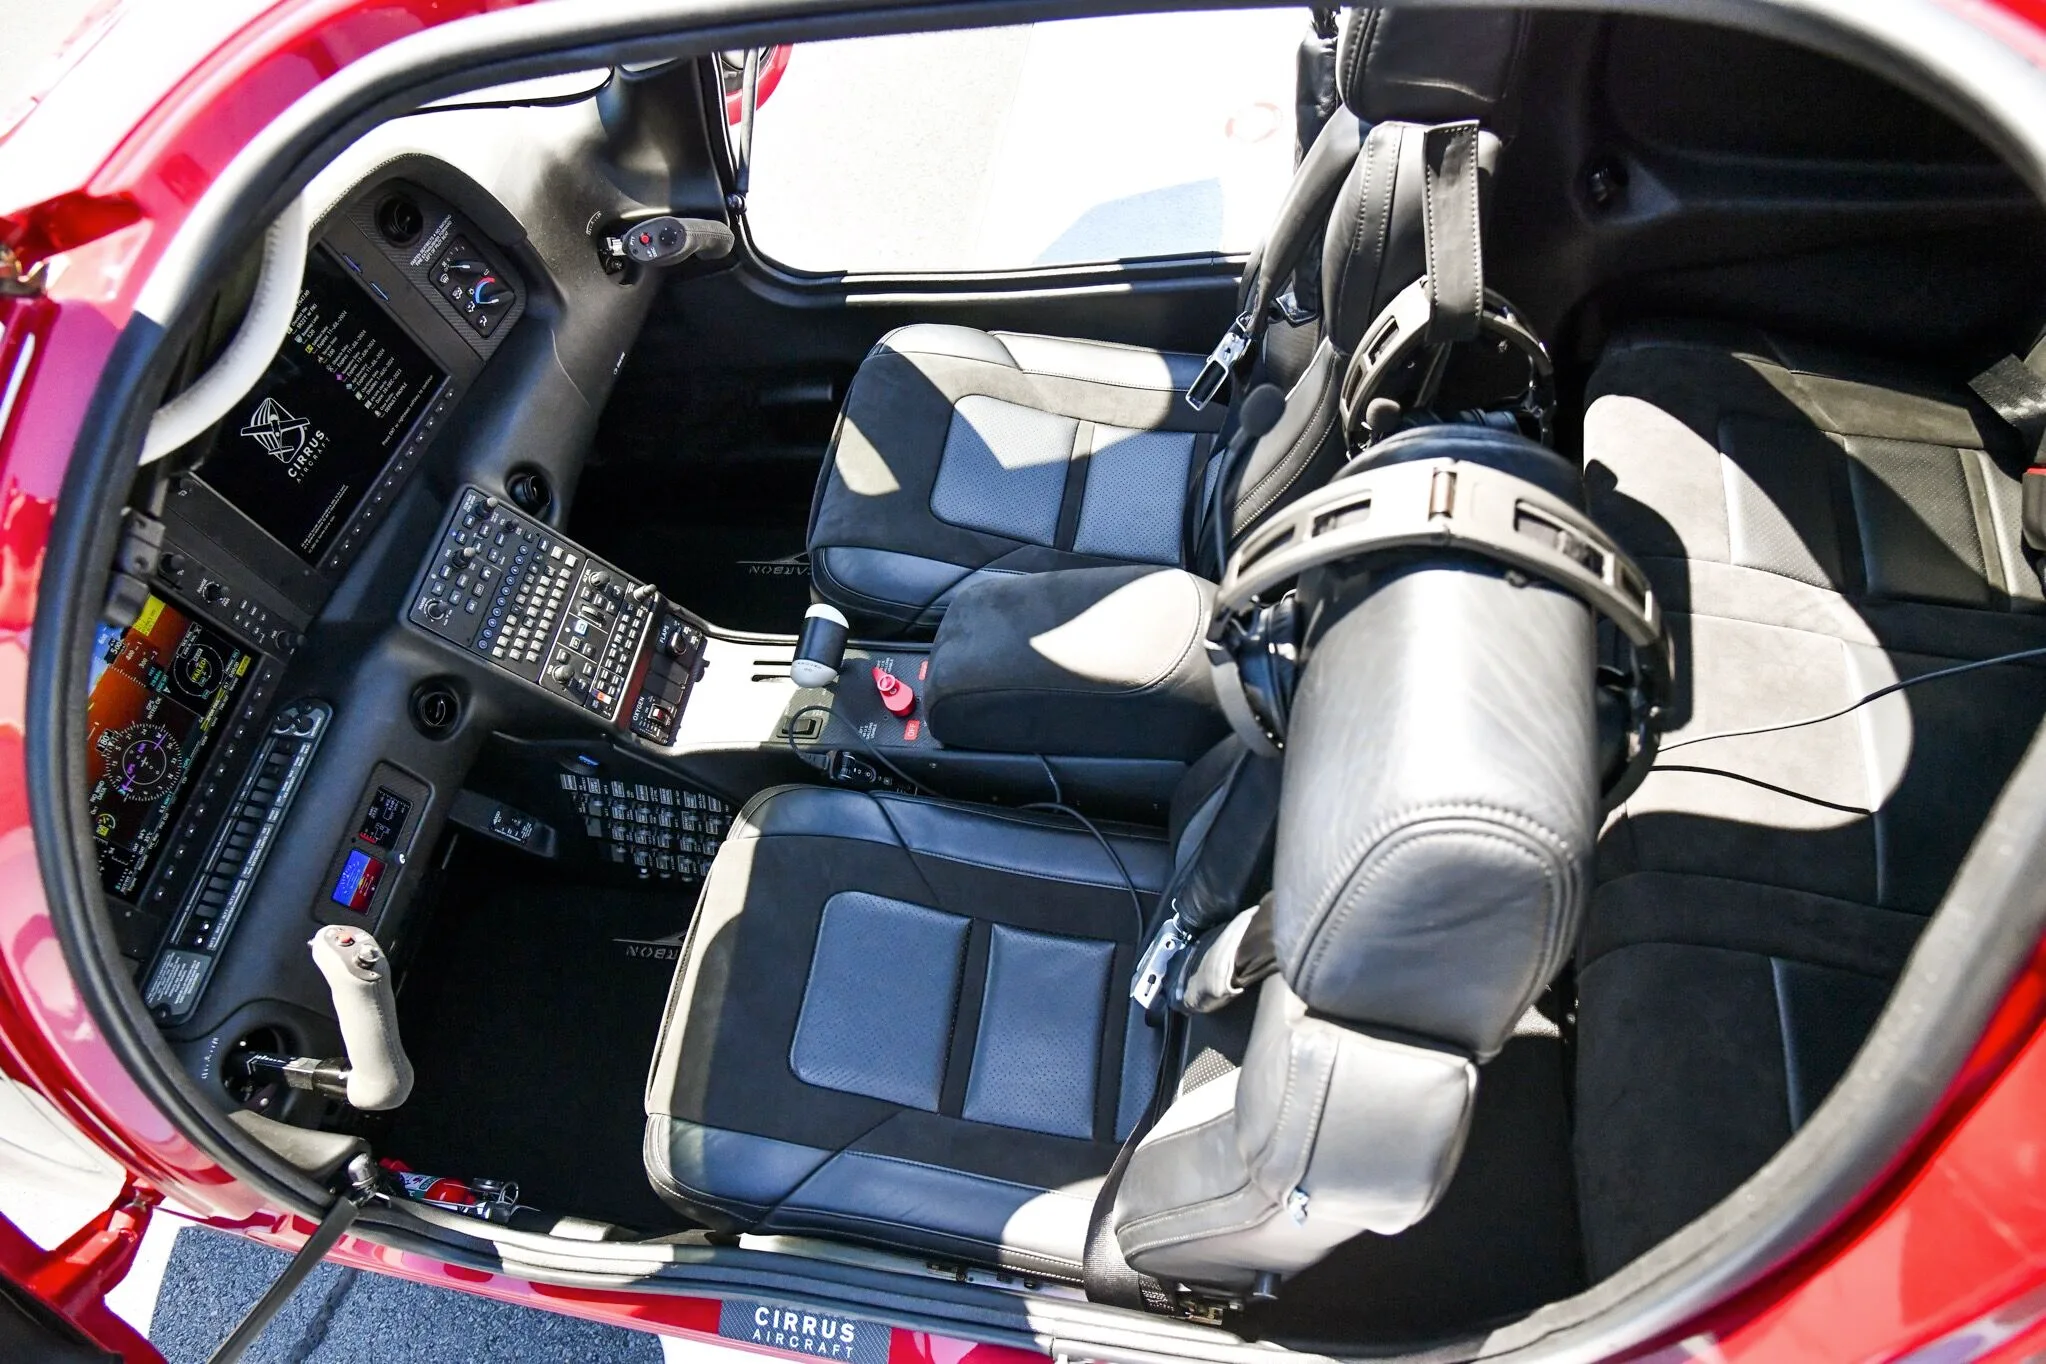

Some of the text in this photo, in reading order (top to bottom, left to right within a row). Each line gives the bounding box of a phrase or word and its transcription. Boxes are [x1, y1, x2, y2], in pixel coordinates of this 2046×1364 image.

[286, 429, 325, 478] CIRRUS
[295, 436, 331, 483] AIRCRAFT
[658, 624, 670, 643] FLAPS
[138, 656, 148, 668] 300
[190, 658, 208, 681] FAILED
[145, 699, 155, 710] GPS
[631, 696, 646, 721] OXYGEN
[906, 722, 916, 737] OFF
[754, 1306, 856, 1343] CIRRUS
[752, 1328, 854, 1359] AIRCRAFT
